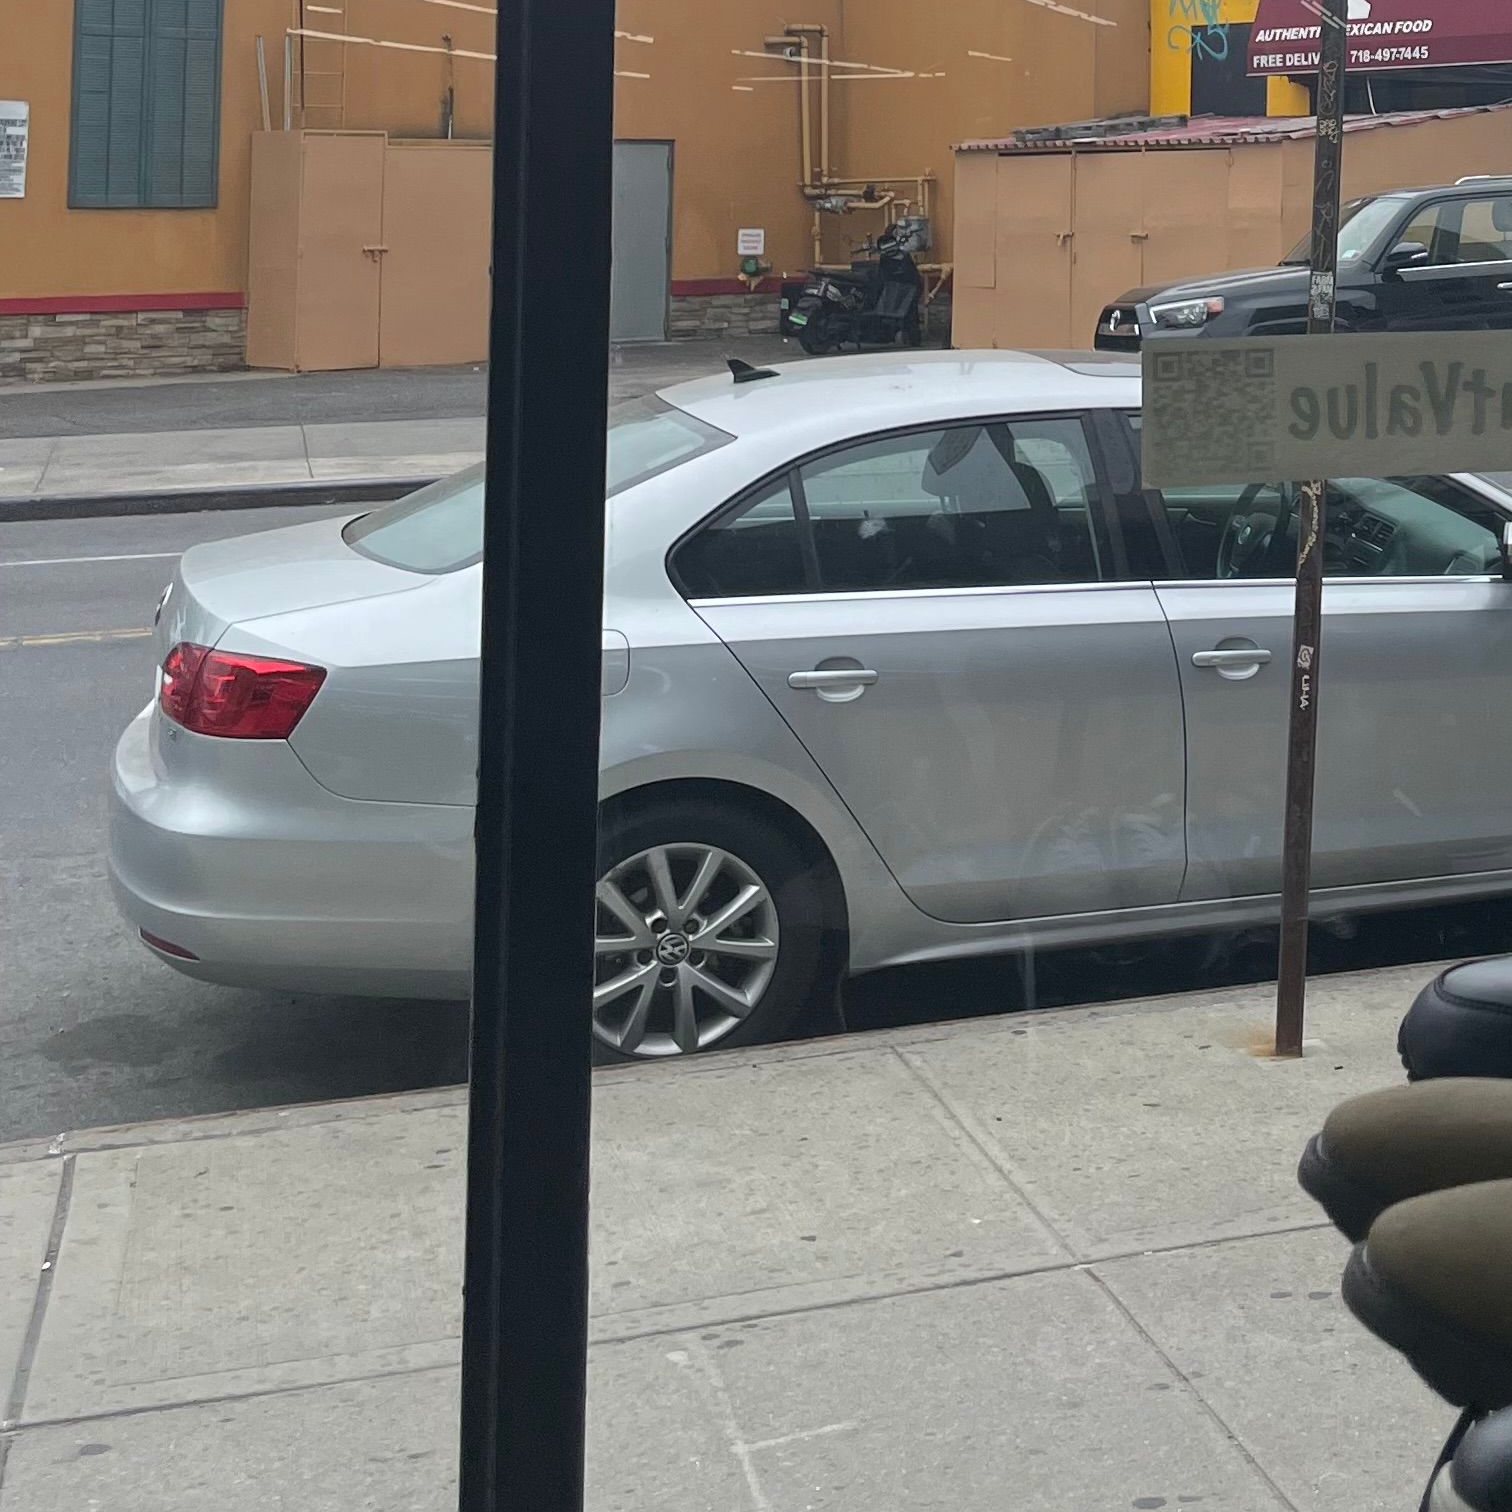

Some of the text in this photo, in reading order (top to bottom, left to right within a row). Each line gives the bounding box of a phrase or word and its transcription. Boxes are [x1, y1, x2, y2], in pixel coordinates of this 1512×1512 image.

[1255, 19, 1433, 43] AUTHENTI EXICAN FOOD
[1253, 46, 1429, 69] FREE DELIV 718-497-7445
